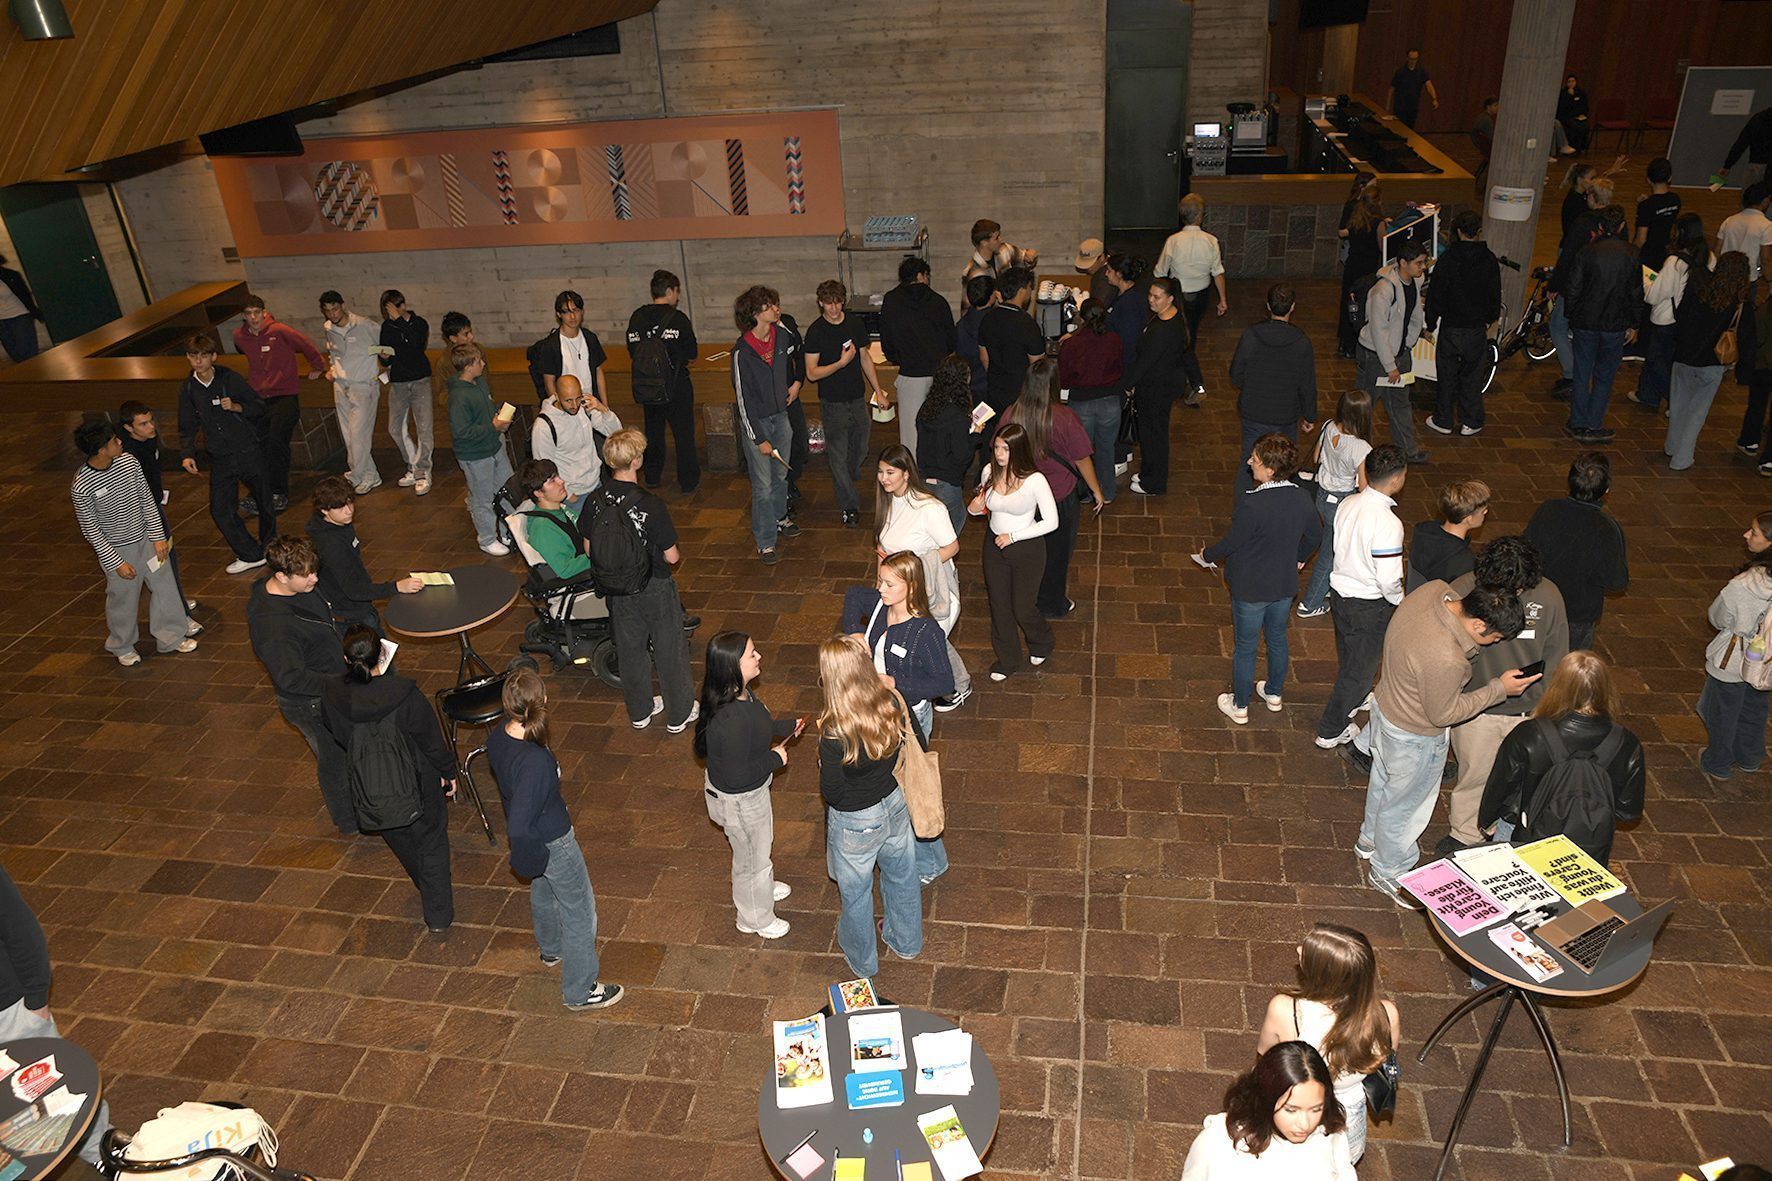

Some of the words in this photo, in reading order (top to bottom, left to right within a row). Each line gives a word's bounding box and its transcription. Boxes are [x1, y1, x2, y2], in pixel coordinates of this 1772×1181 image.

[1549, 853, 1578, 868] sind?
[1481, 868, 1529, 885] YouCare
[1543, 863, 1581, 878] Carers
[1559, 868, 1597, 884] Young
[1508, 875, 1537, 887] Hilfe
[1587, 874, 1604, 883] du
[1456, 885, 1474, 896] für
[1490, 883, 1509, 895] auf
[1514, 883, 1545, 895] finde
[1564, 879, 1590, 891] was
[1577, 881, 1615, 897] Weißt
[1438, 892, 1456, 902] die
[1454, 892, 1482, 906] Care
[1496, 892, 1518, 902] ich
[1529, 890, 1554, 901] Wie
[1454, 900, 1491, 919] Young
[1471, 905, 1500, 920] Dein
